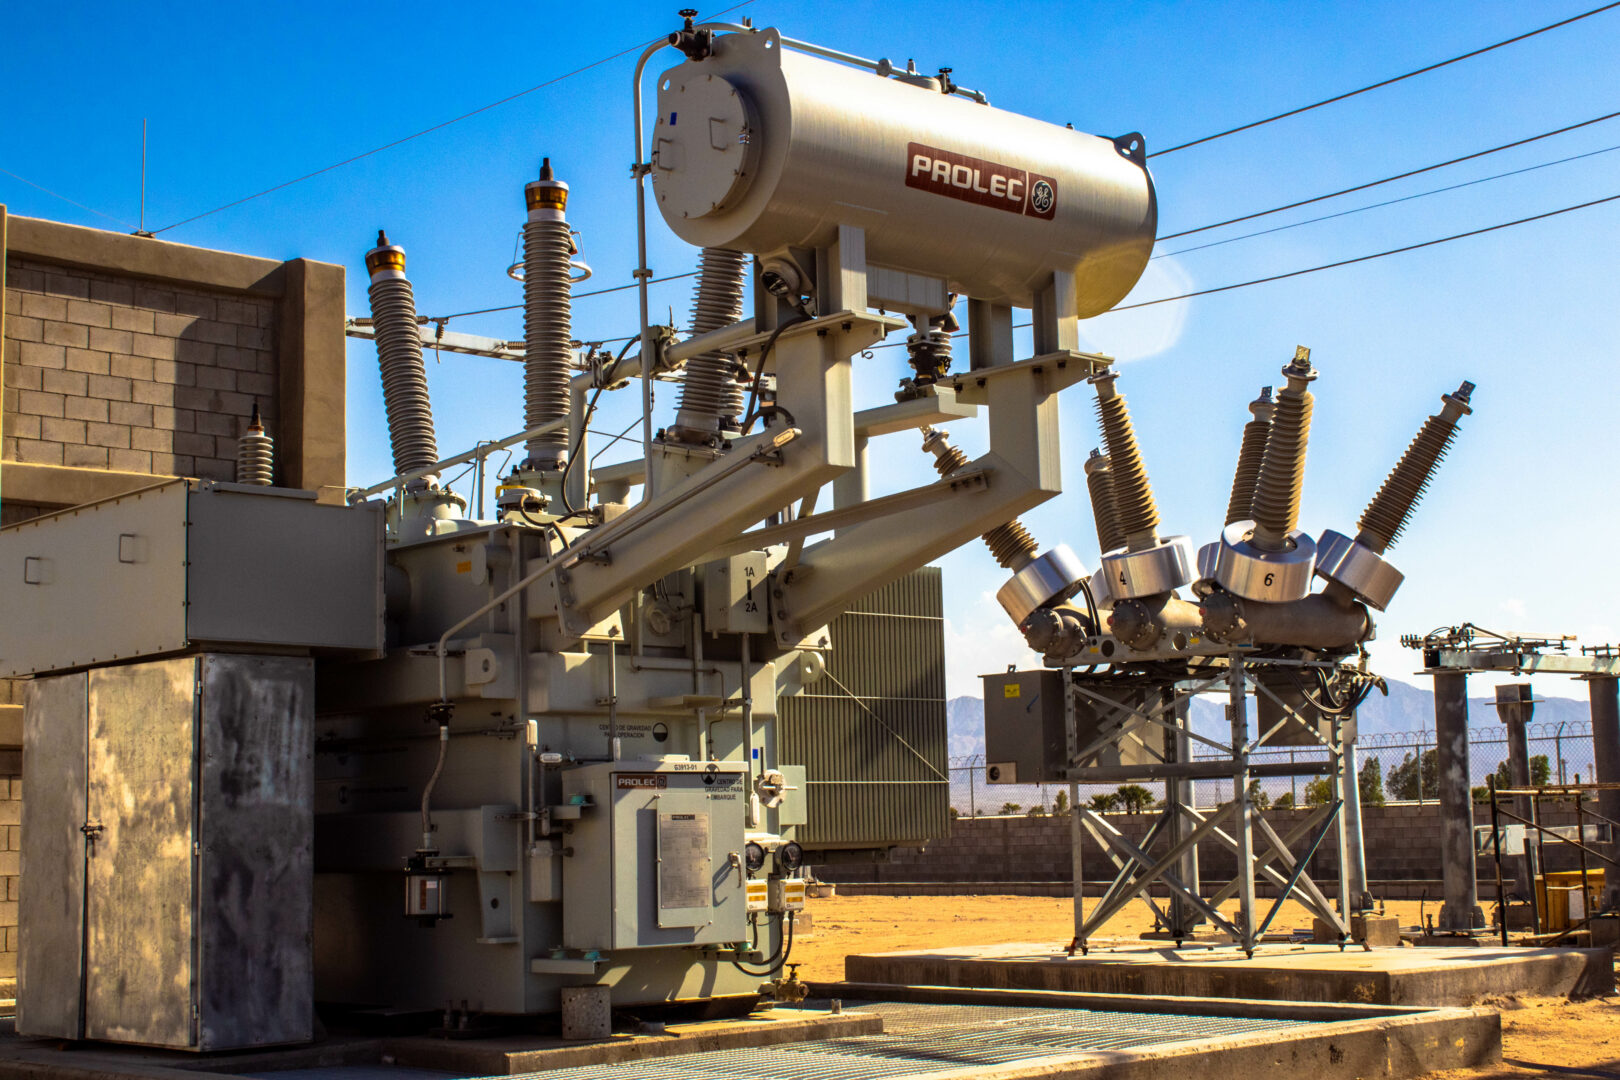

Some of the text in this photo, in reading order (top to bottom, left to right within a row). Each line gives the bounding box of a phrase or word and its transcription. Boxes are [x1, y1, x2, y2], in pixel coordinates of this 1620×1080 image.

[912, 154, 1024, 202] PROLEC
[744, 566, 755, 577] 1A
[1119, 571, 1127, 586] 4
[1264, 572, 1275, 587] 6
[745, 601, 758, 613] 2A
[618, 778, 655, 786] PROLEC
